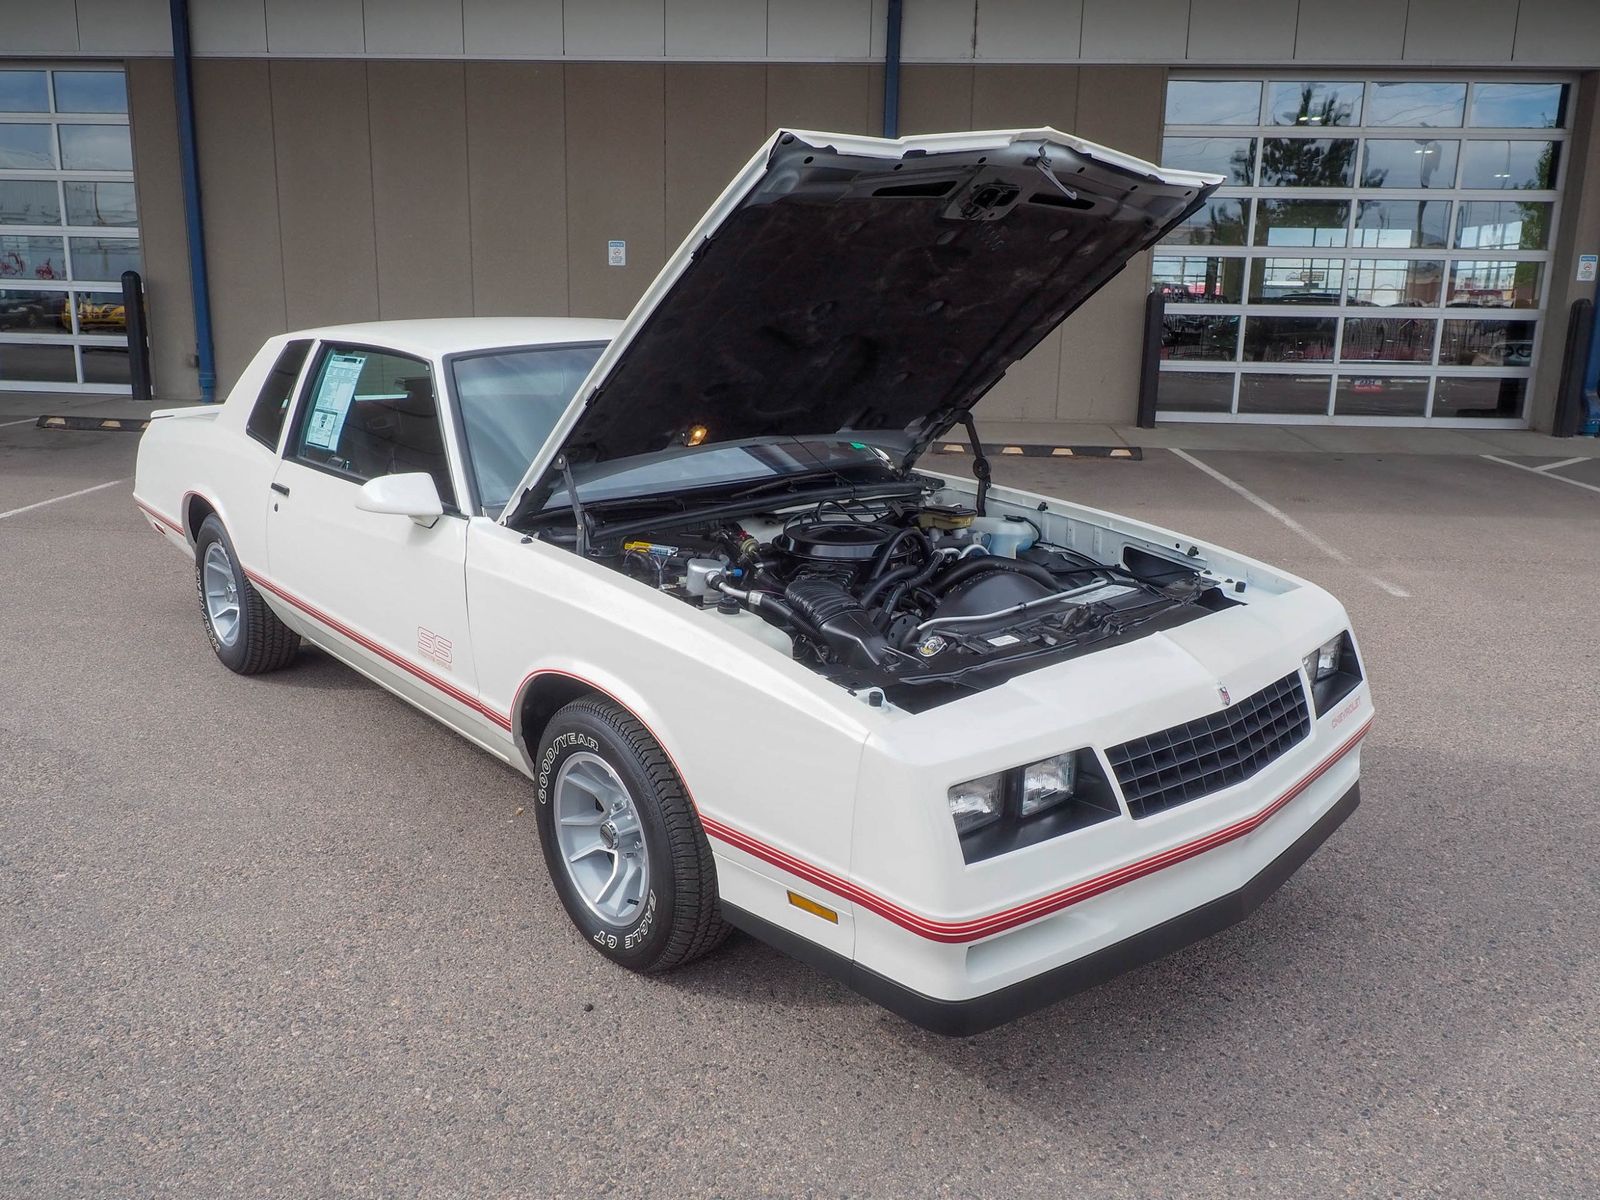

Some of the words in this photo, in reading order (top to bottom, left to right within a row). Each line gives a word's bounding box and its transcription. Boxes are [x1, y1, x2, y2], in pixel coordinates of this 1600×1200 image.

[417, 626, 453, 664] SS
[1331, 695, 1361, 729] CHEVROLET
[538, 732, 599, 804] GOODYEAR
[624, 889, 657, 949] EAGLE
[594, 930, 617, 949] GT
